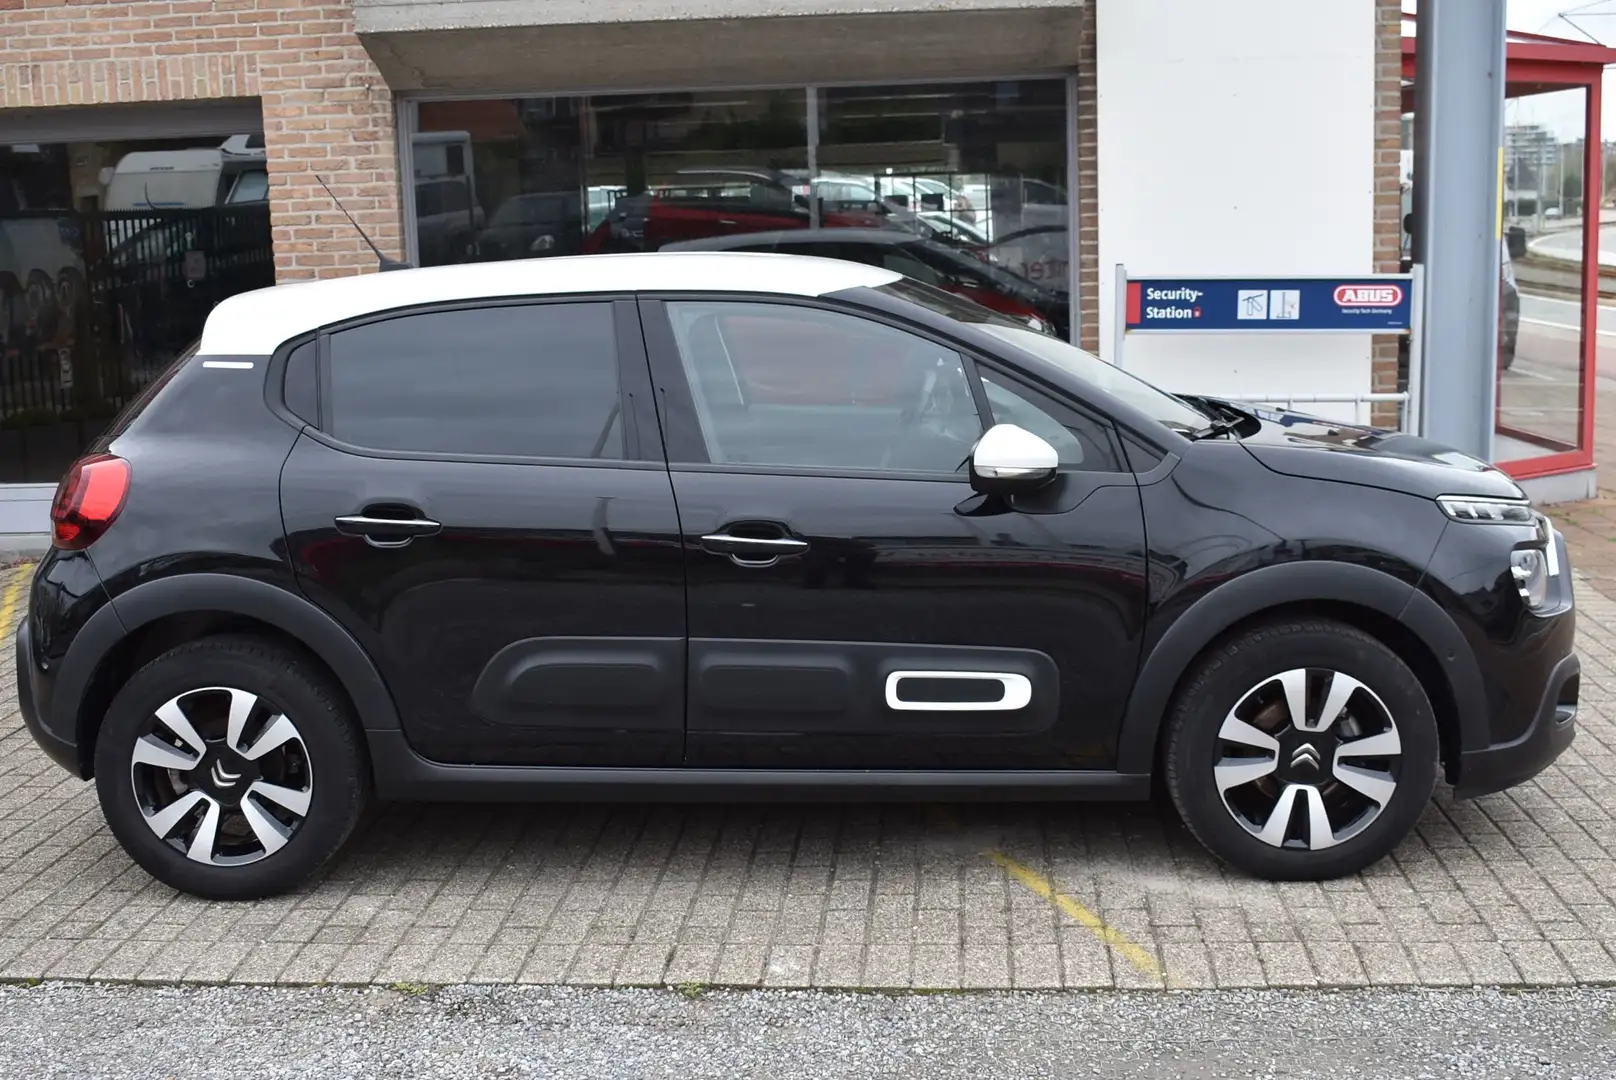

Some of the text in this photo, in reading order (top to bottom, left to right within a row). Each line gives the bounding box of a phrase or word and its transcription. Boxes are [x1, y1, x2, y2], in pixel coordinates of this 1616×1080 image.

[1146, 287, 1204, 303] Security-
[1342, 289, 1394, 302] ABUS
[1146, 305, 1193, 319] Station
